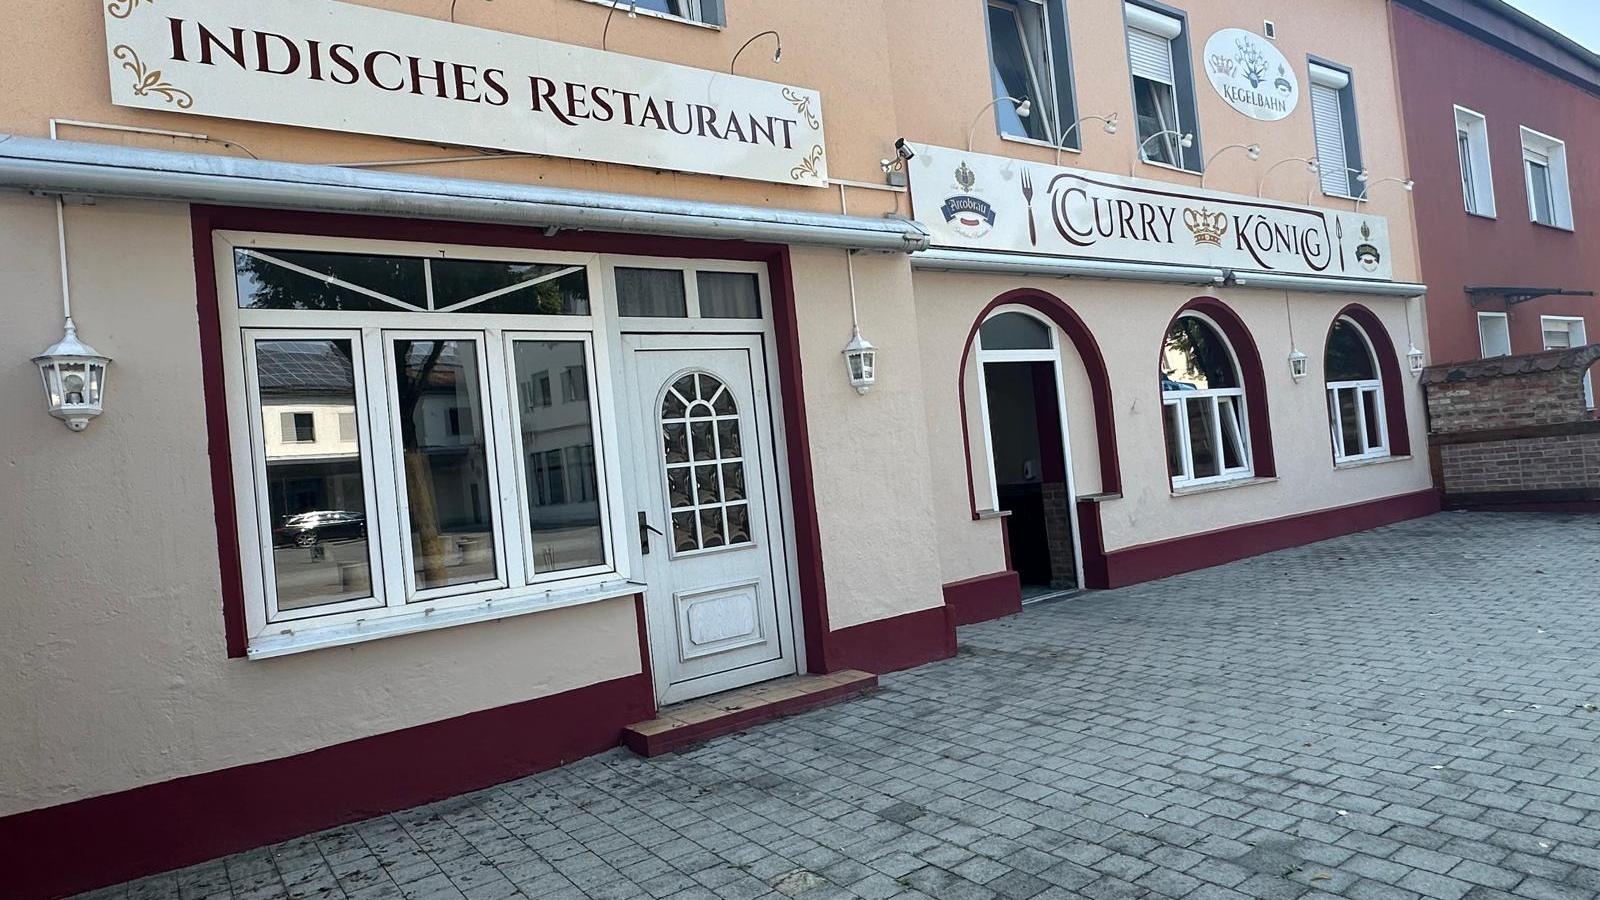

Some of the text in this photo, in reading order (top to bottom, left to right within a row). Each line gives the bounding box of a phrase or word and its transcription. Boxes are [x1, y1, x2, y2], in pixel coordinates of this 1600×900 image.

[166, 16, 796, 149] INDISCHES RESTAURANT
[1224, 84, 1286, 112] KEGELBAHN
[1051, 187, 1176, 247] CURRY
